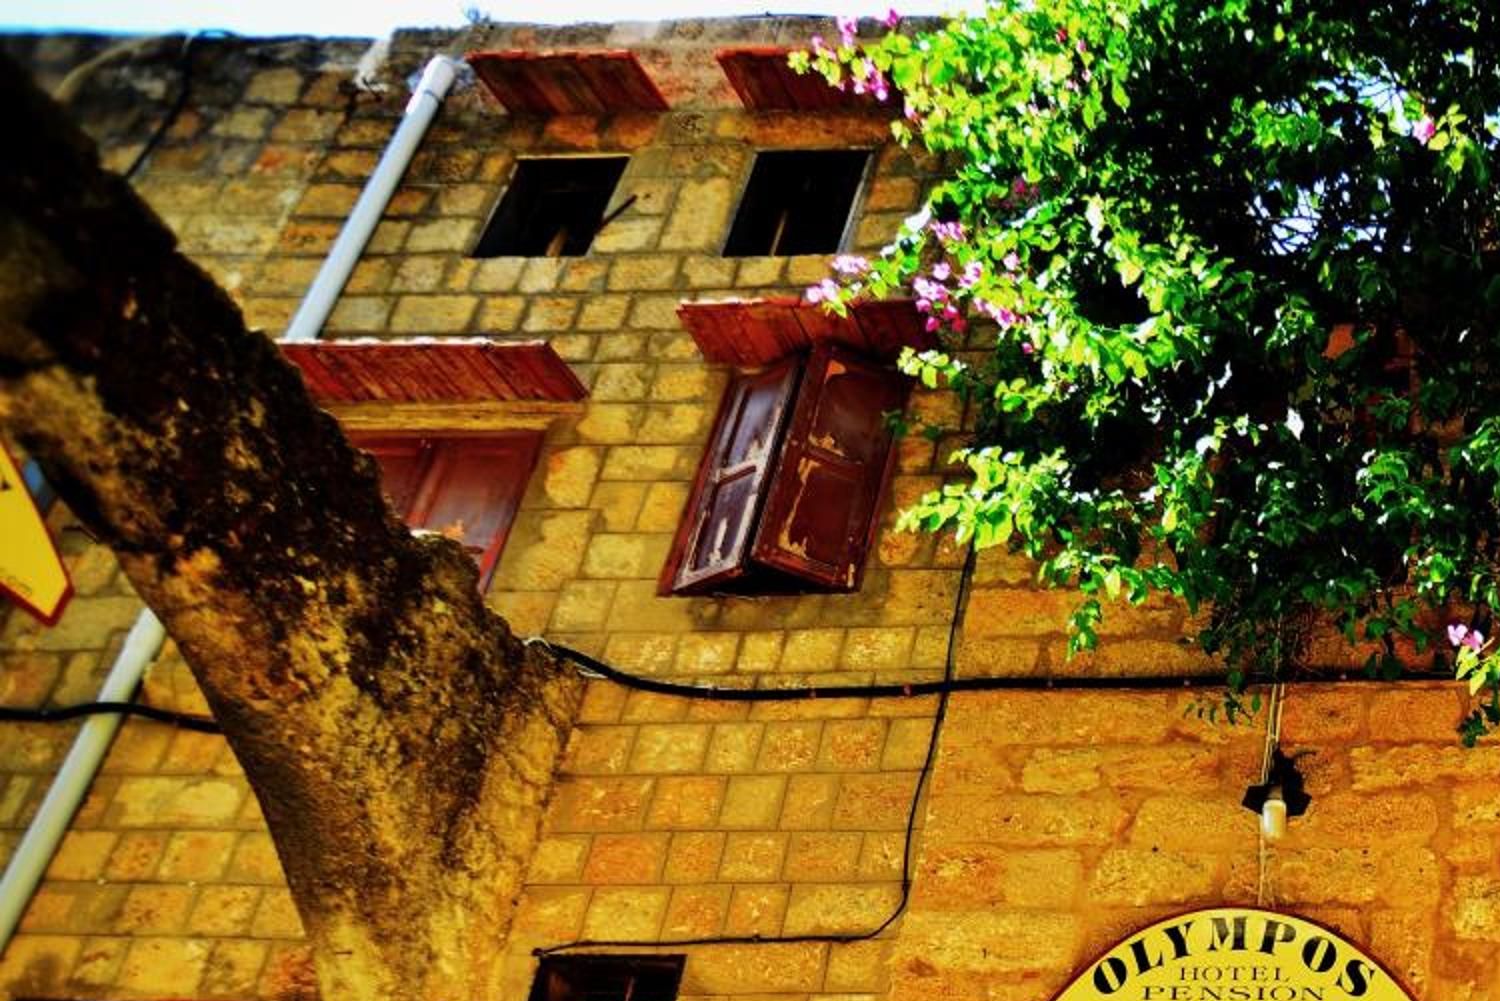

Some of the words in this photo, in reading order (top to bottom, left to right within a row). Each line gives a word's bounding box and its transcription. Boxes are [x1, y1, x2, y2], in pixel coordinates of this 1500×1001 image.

[1093, 916, 1375, 997] OLYMPOS
[1179, 966, 1290, 982] HOTEL
[1142, 985, 1325, 1001] PENSION
